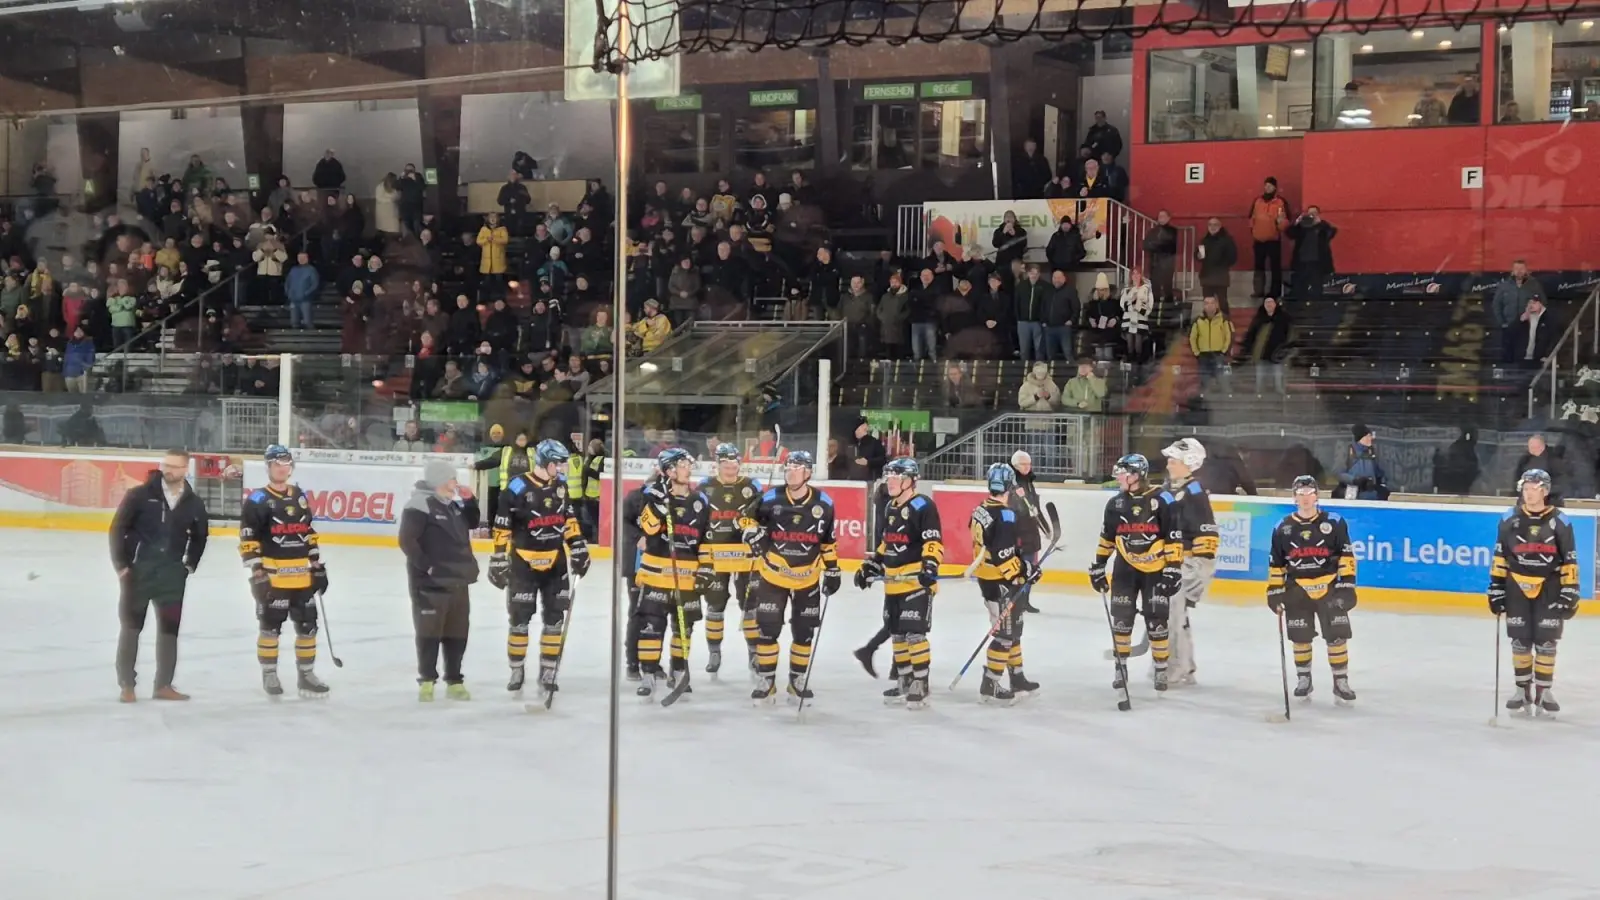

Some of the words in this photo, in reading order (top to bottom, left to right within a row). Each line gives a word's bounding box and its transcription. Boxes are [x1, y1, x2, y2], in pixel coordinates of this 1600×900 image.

[864, 85, 914, 97] FERNSEHEN
[932, 83, 959, 94] REGIE
[751, 91, 796, 104] RUNDFUNK
[1189, 166, 1200, 180] E
[1467, 170, 1478, 184] F
[977, 214, 1048, 229] LEEN
[817, 519, 825, 534] C
[1217, 517, 1247, 532] ADT
[1351, 535, 1393, 562] ein
[1403, 537, 1491, 567] Leben
